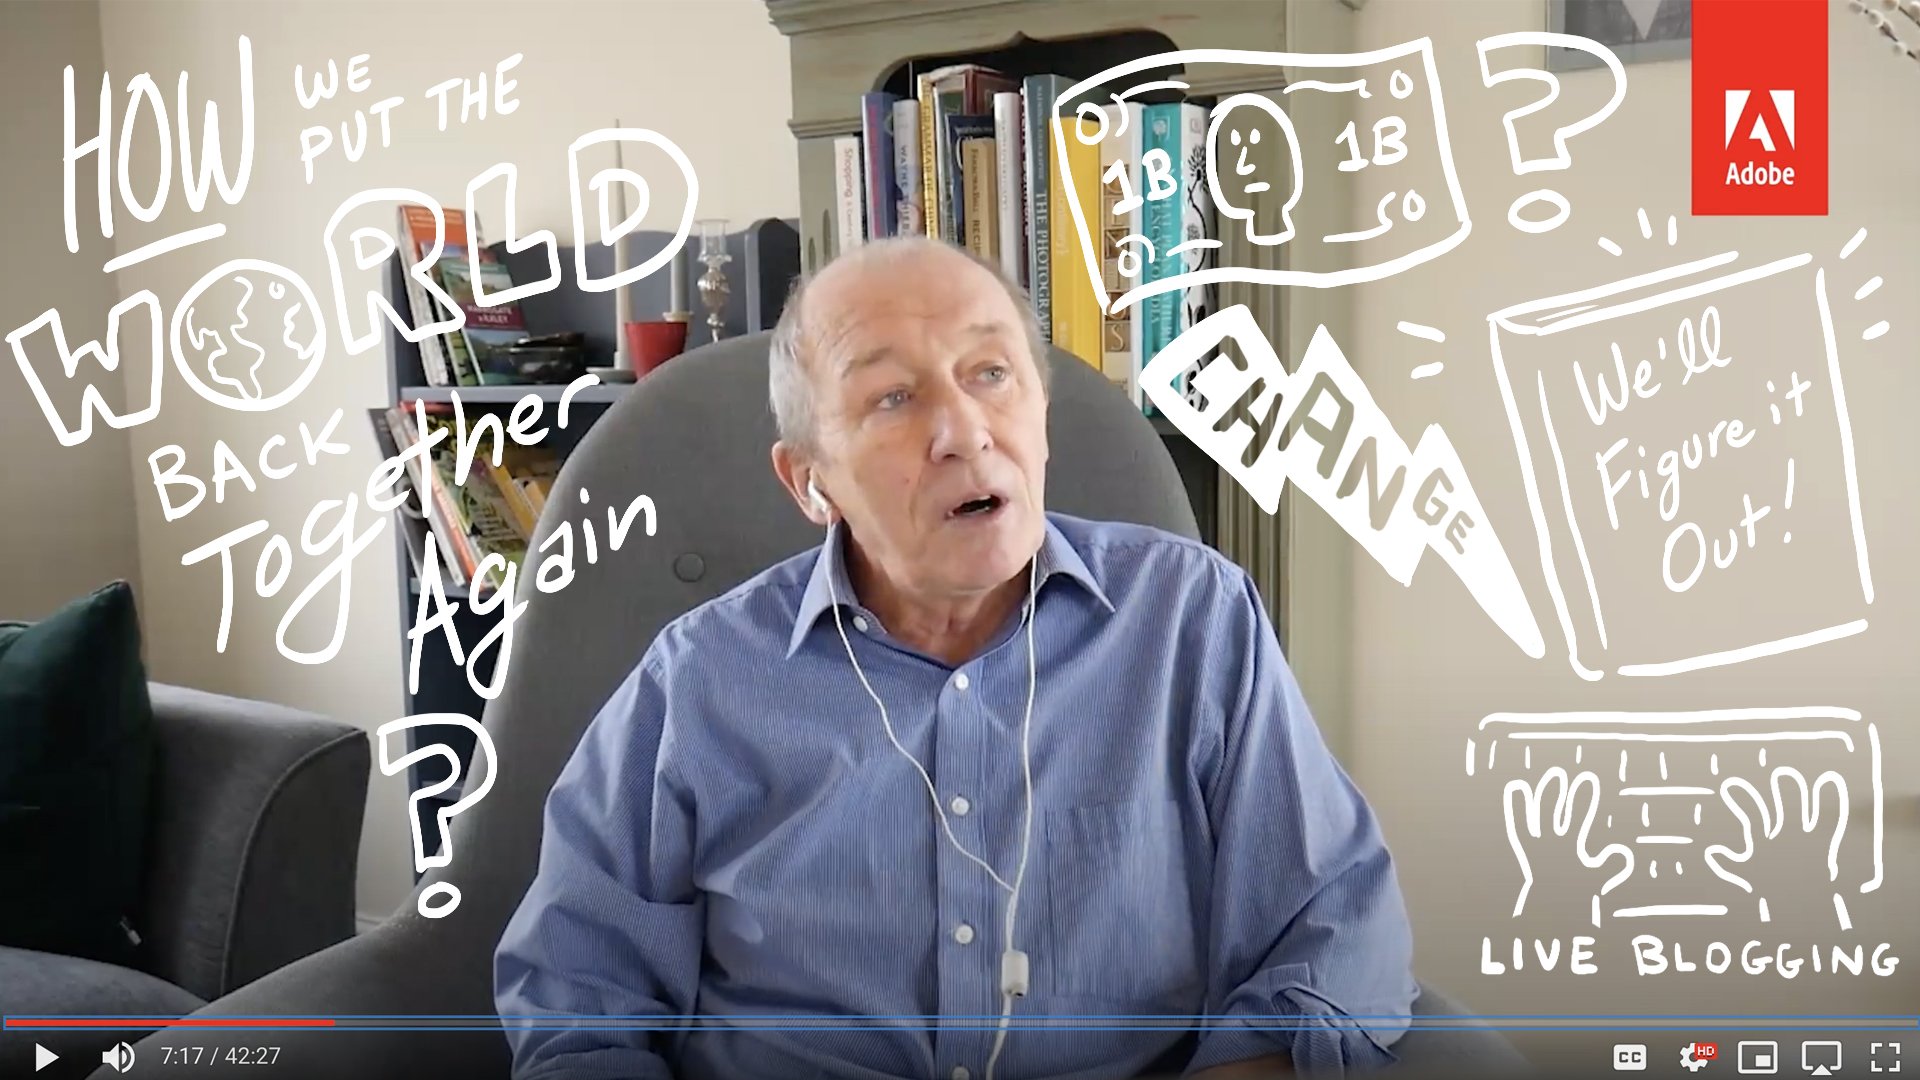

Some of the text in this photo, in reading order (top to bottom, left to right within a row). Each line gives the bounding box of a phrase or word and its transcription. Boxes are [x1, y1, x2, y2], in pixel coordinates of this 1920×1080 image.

[900, 145, 909, 188] WAYNE
[901, 192, 911, 234] THIEB
[1035, 190, 1048, 225] THE
